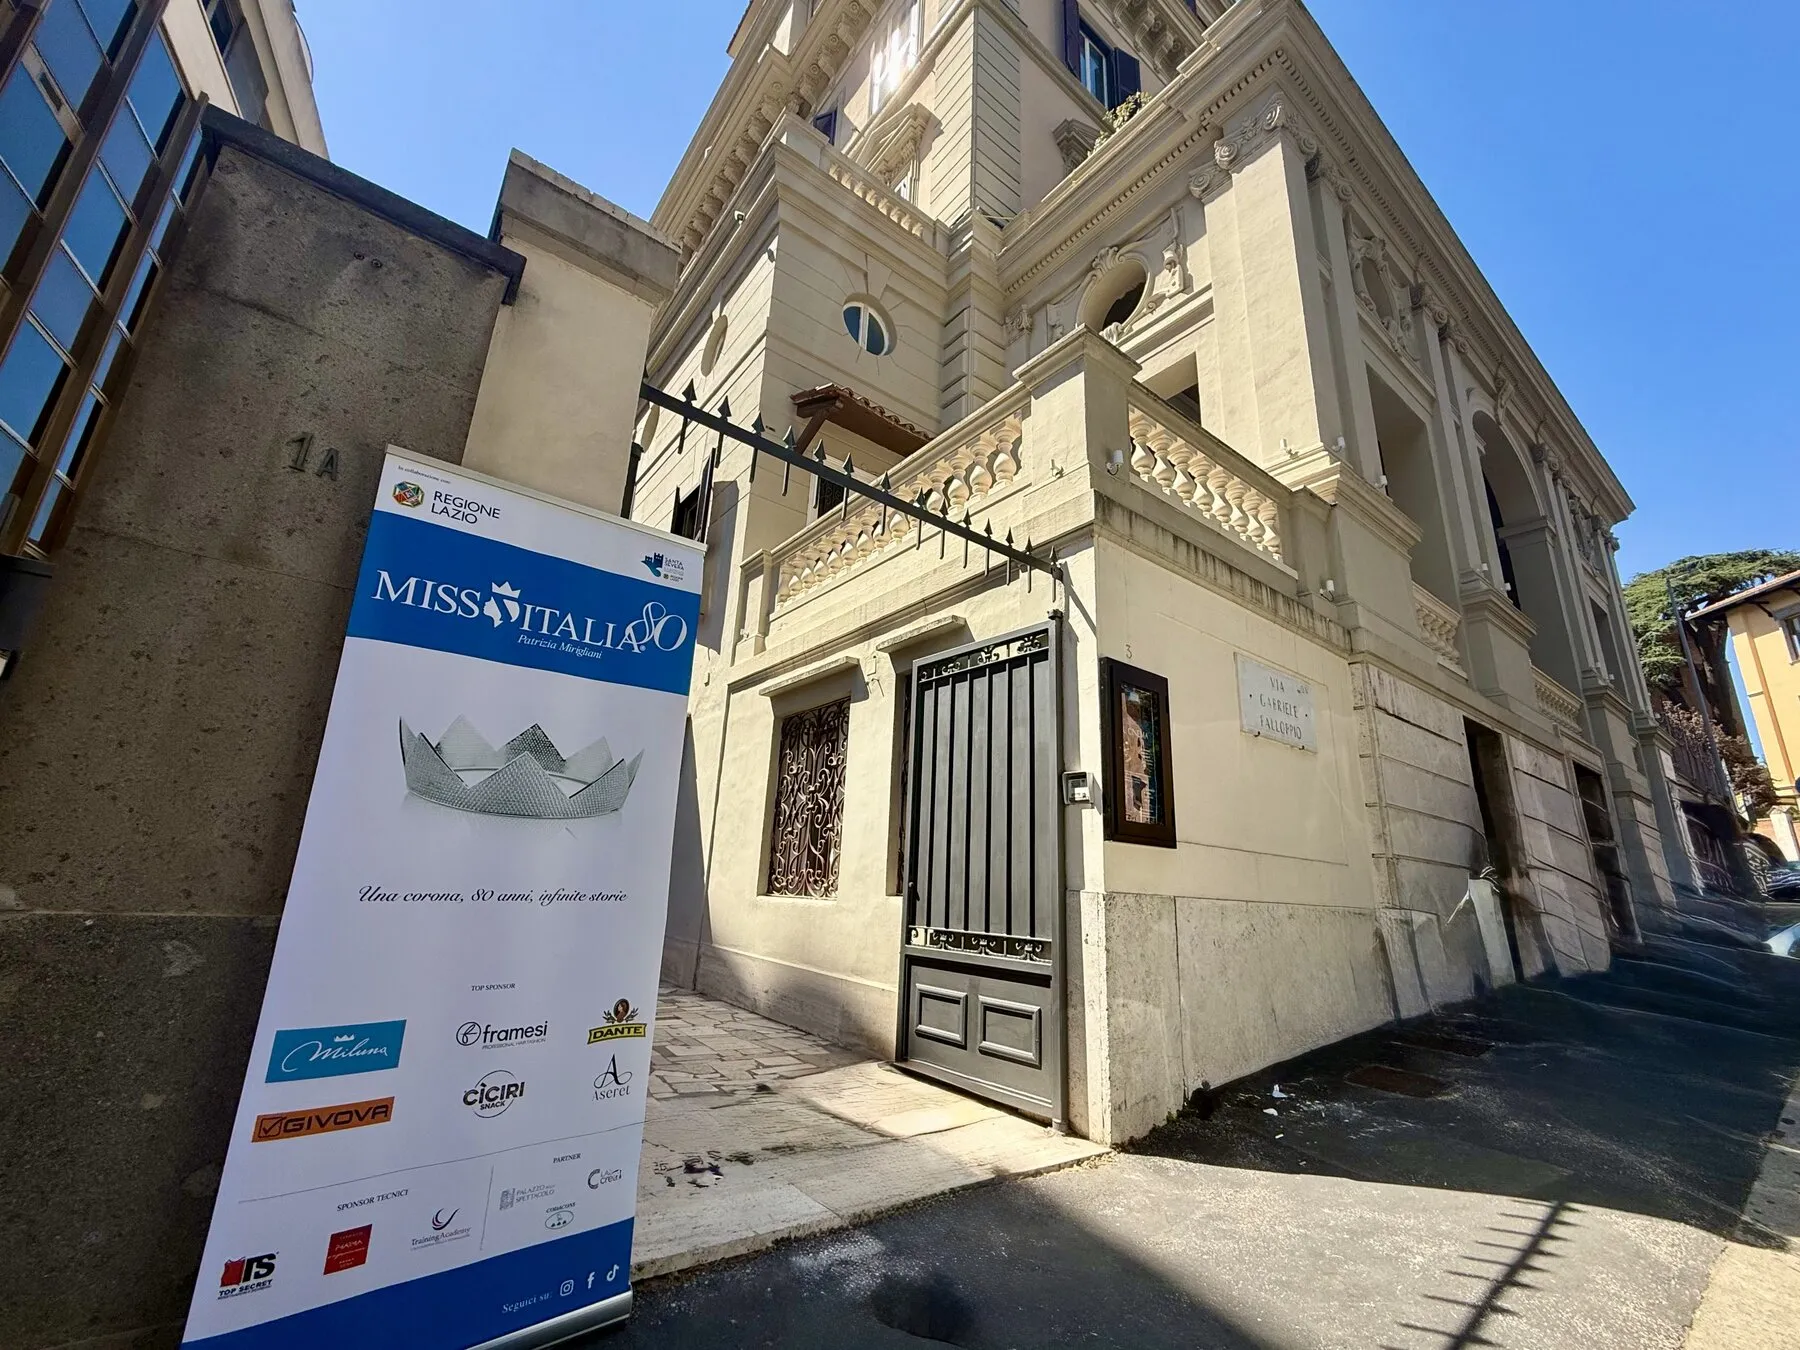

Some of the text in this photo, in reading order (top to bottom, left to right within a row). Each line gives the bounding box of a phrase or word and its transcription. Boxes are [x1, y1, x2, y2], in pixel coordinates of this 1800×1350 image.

[431, 502, 478, 524] LAZIO
[433, 490, 501, 519] REGIONE
[372, 569, 481, 619] MISS
[519, 603, 643, 653] ITALIA
[517, 634, 603, 659] Patrizia Mirigliani
[1125, 643, 1133, 660] 3
[1269, 676, 1285, 692] VIA
[1260, 693, 1298, 719] GABRIELE
[1260, 714, 1302, 740] FALLOPPIO
[358, 885, 627, 907] Una corona, 80 anni, infinite storie
[471, 982, 516, 992] TOP SPONSOR
[483, 1020, 548, 1044] framesi
[592, 1026, 643, 1040] DANTE
[281, 1037, 389, 1073] Miluna
[592, 1085, 630, 1101] Aseret
[480, 1100, 506, 1111] SNACK
[283, 1104, 389, 1133] GIVOVA
[552, 1153, 582, 1164] PARTNER
[336, 1189, 409, 1212] SPONSOR TECNICI
[219, 1287, 237, 1297] TOP
[238, 1279, 274, 1292] SECRET
[501, 1294, 538, 1314] Seguici
